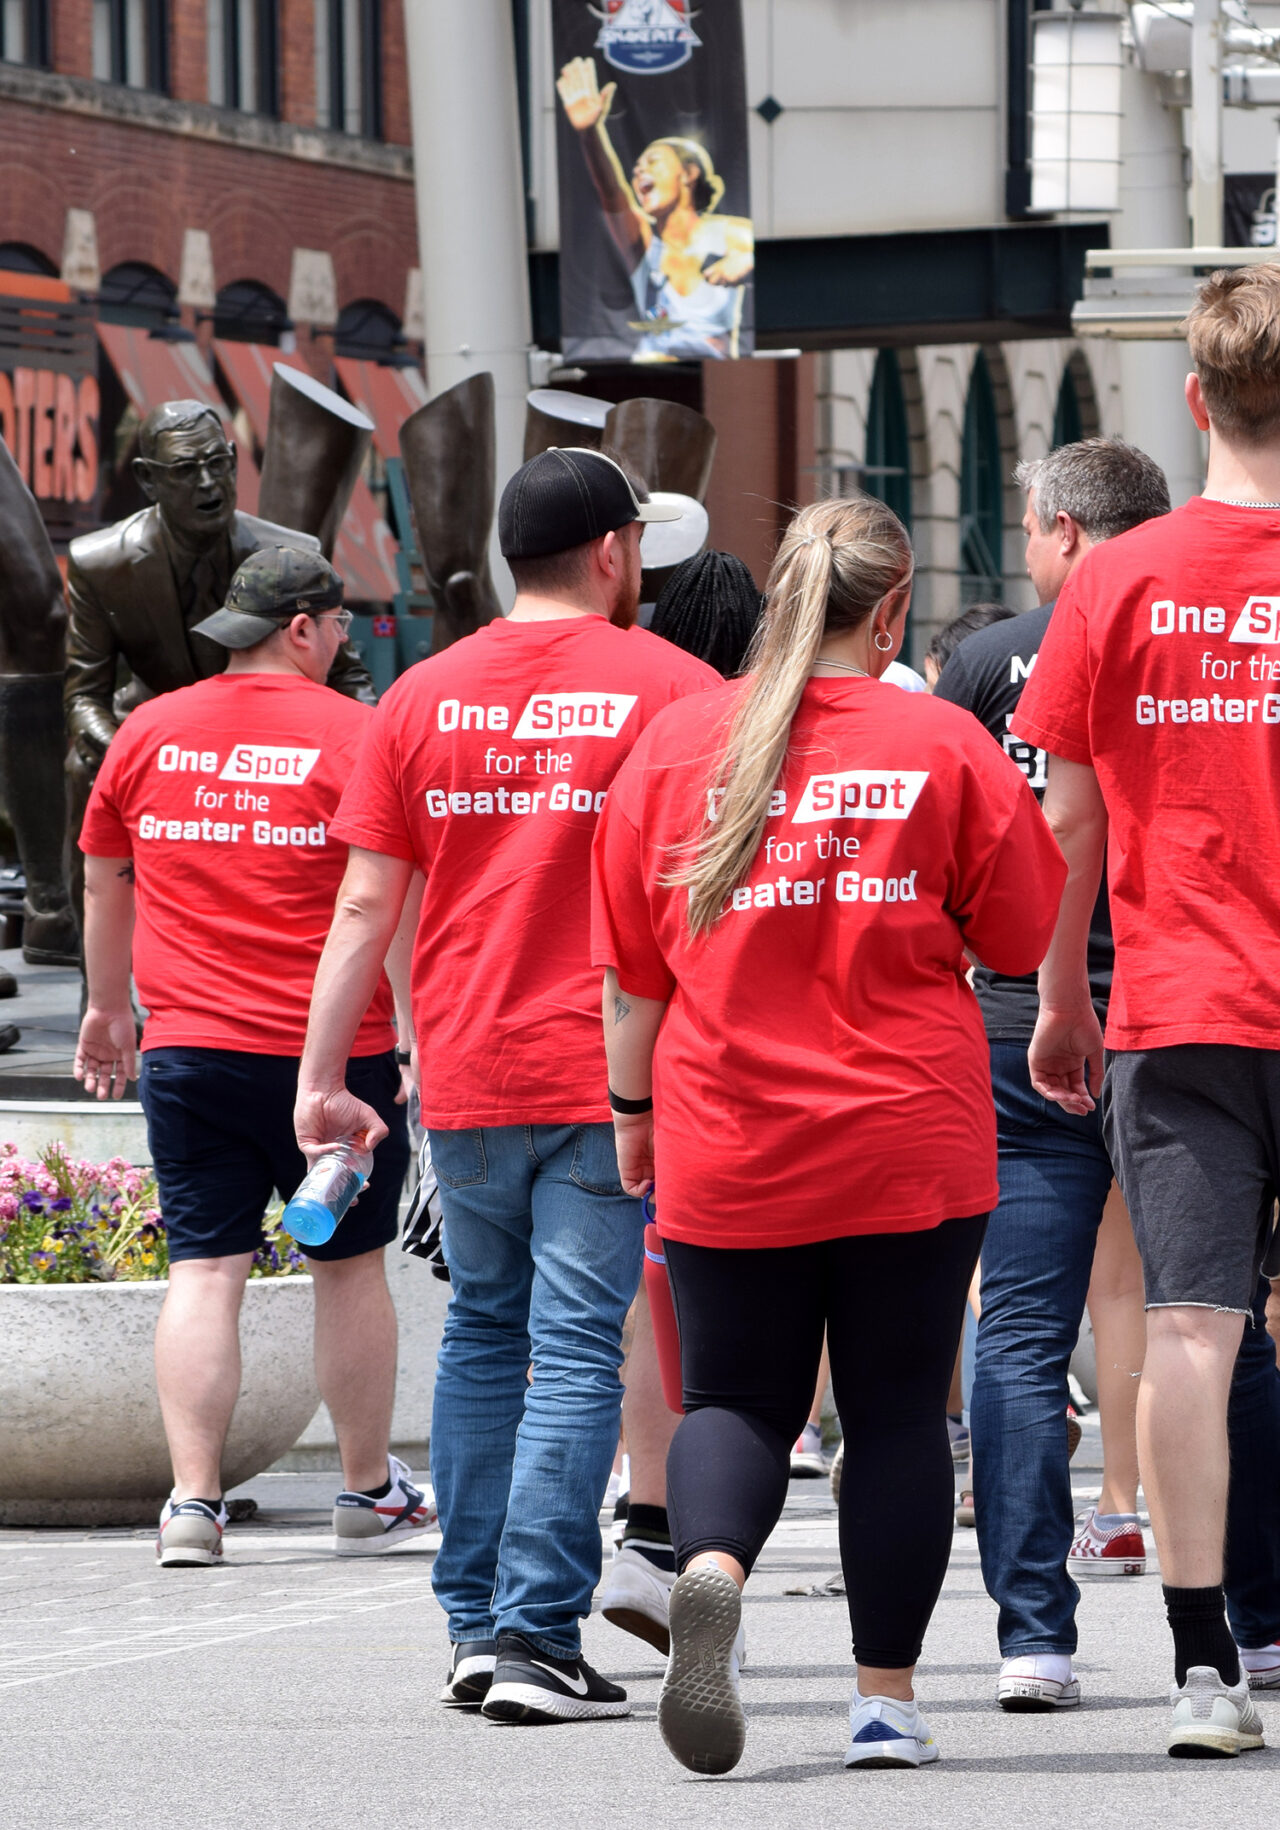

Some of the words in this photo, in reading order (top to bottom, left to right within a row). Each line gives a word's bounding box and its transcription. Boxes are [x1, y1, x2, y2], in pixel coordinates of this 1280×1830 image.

[1150, 599, 1226, 635] One
[1200, 651, 1242, 681] for
[438, 699, 509, 733] One
[530, 698, 617, 736] Spot
[1136, 693, 1259, 726] Greater
[157, 744, 218, 773] One
[234, 748, 304, 780] Spot
[484, 747, 526, 775] for
[533, 747, 572, 775] the
[194, 785, 228, 809] for
[234, 788, 270, 812] the
[425, 786, 546, 818] Geater
[549, 782, 609, 814] Goo
[811, 777, 906, 817] Spot
[139, 814, 245, 843] Greater
[252, 820, 326, 846] Good
[765, 835, 807, 864] for
[814, 830, 860, 860] the
[835, 870, 918, 903] Good
